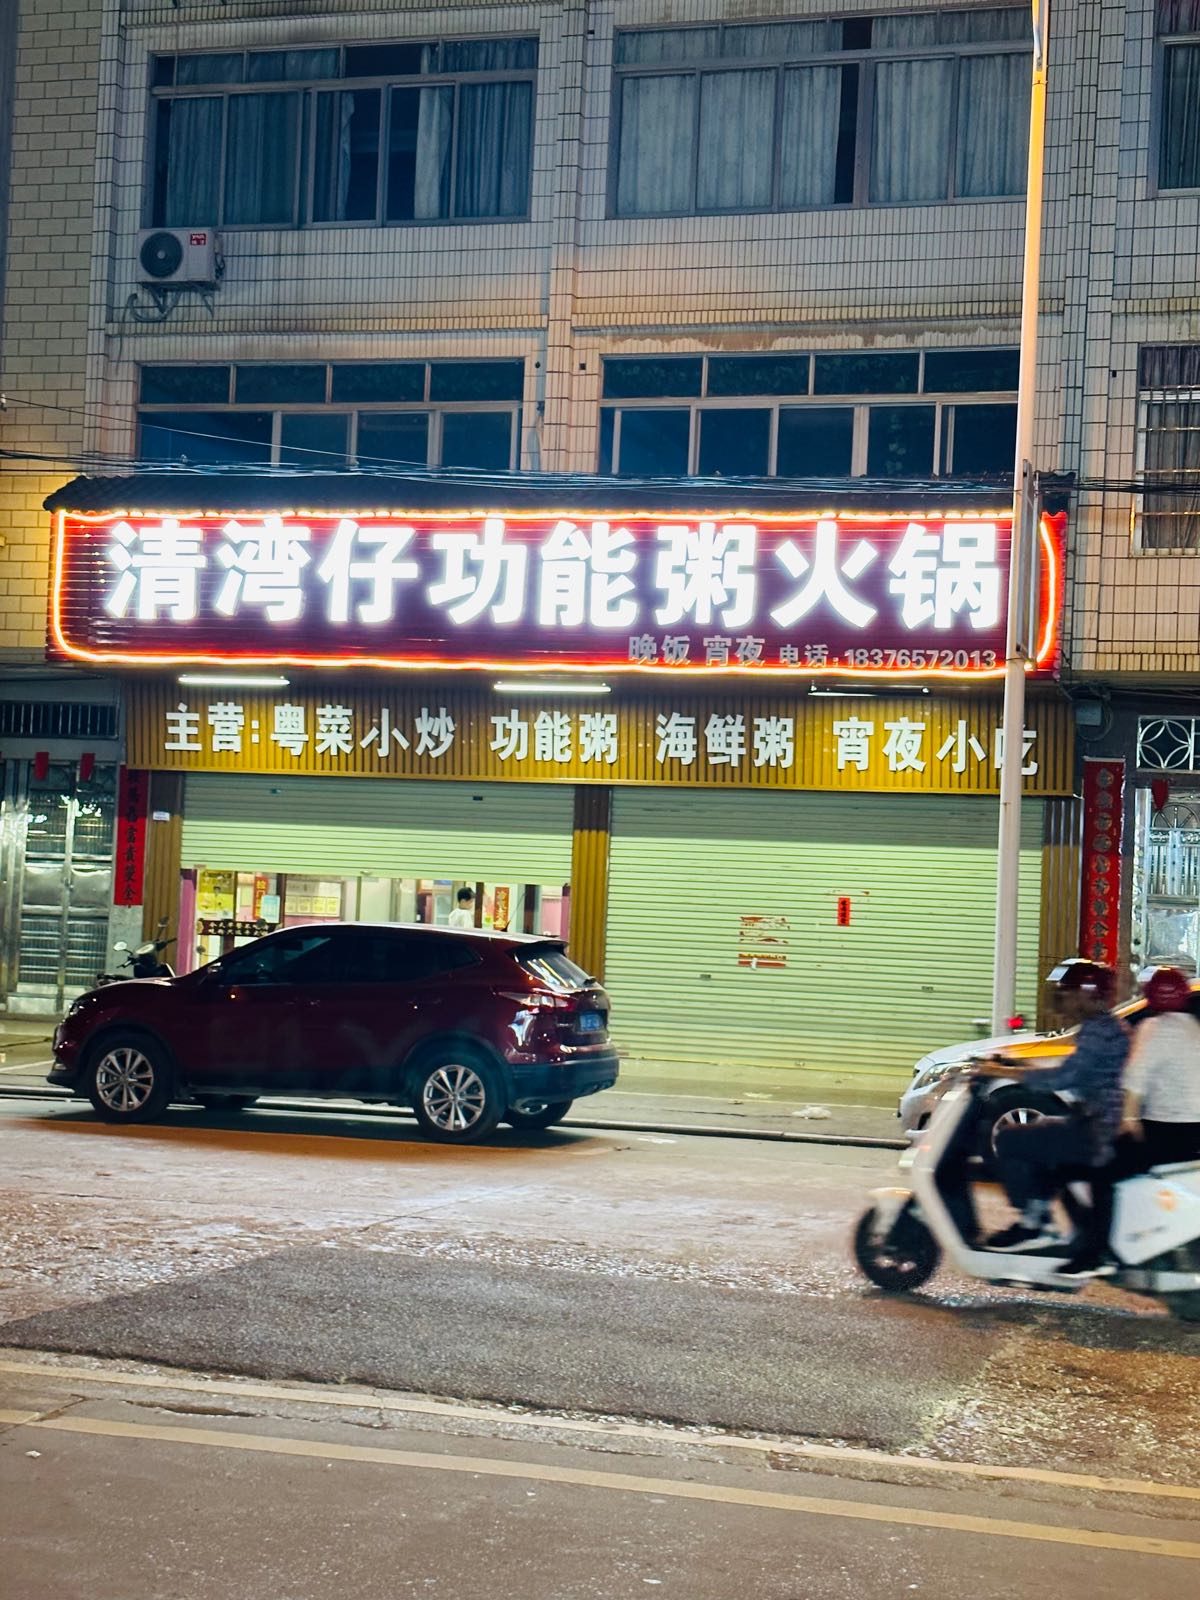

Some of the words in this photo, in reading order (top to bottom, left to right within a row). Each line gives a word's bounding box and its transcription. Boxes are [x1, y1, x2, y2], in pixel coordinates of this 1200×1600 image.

[106, 518, 1001, 629] 清湾仔功能粥火锅
[628, 633, 691, 666] 晚饭
[703, 634, 766, 666] 宵夜
[164, 702, 456, 759] 主营:粤菜小炒
[490, 708, 620, 764] 功能粥
[656, 711, 795, 769] 海鲜粥
